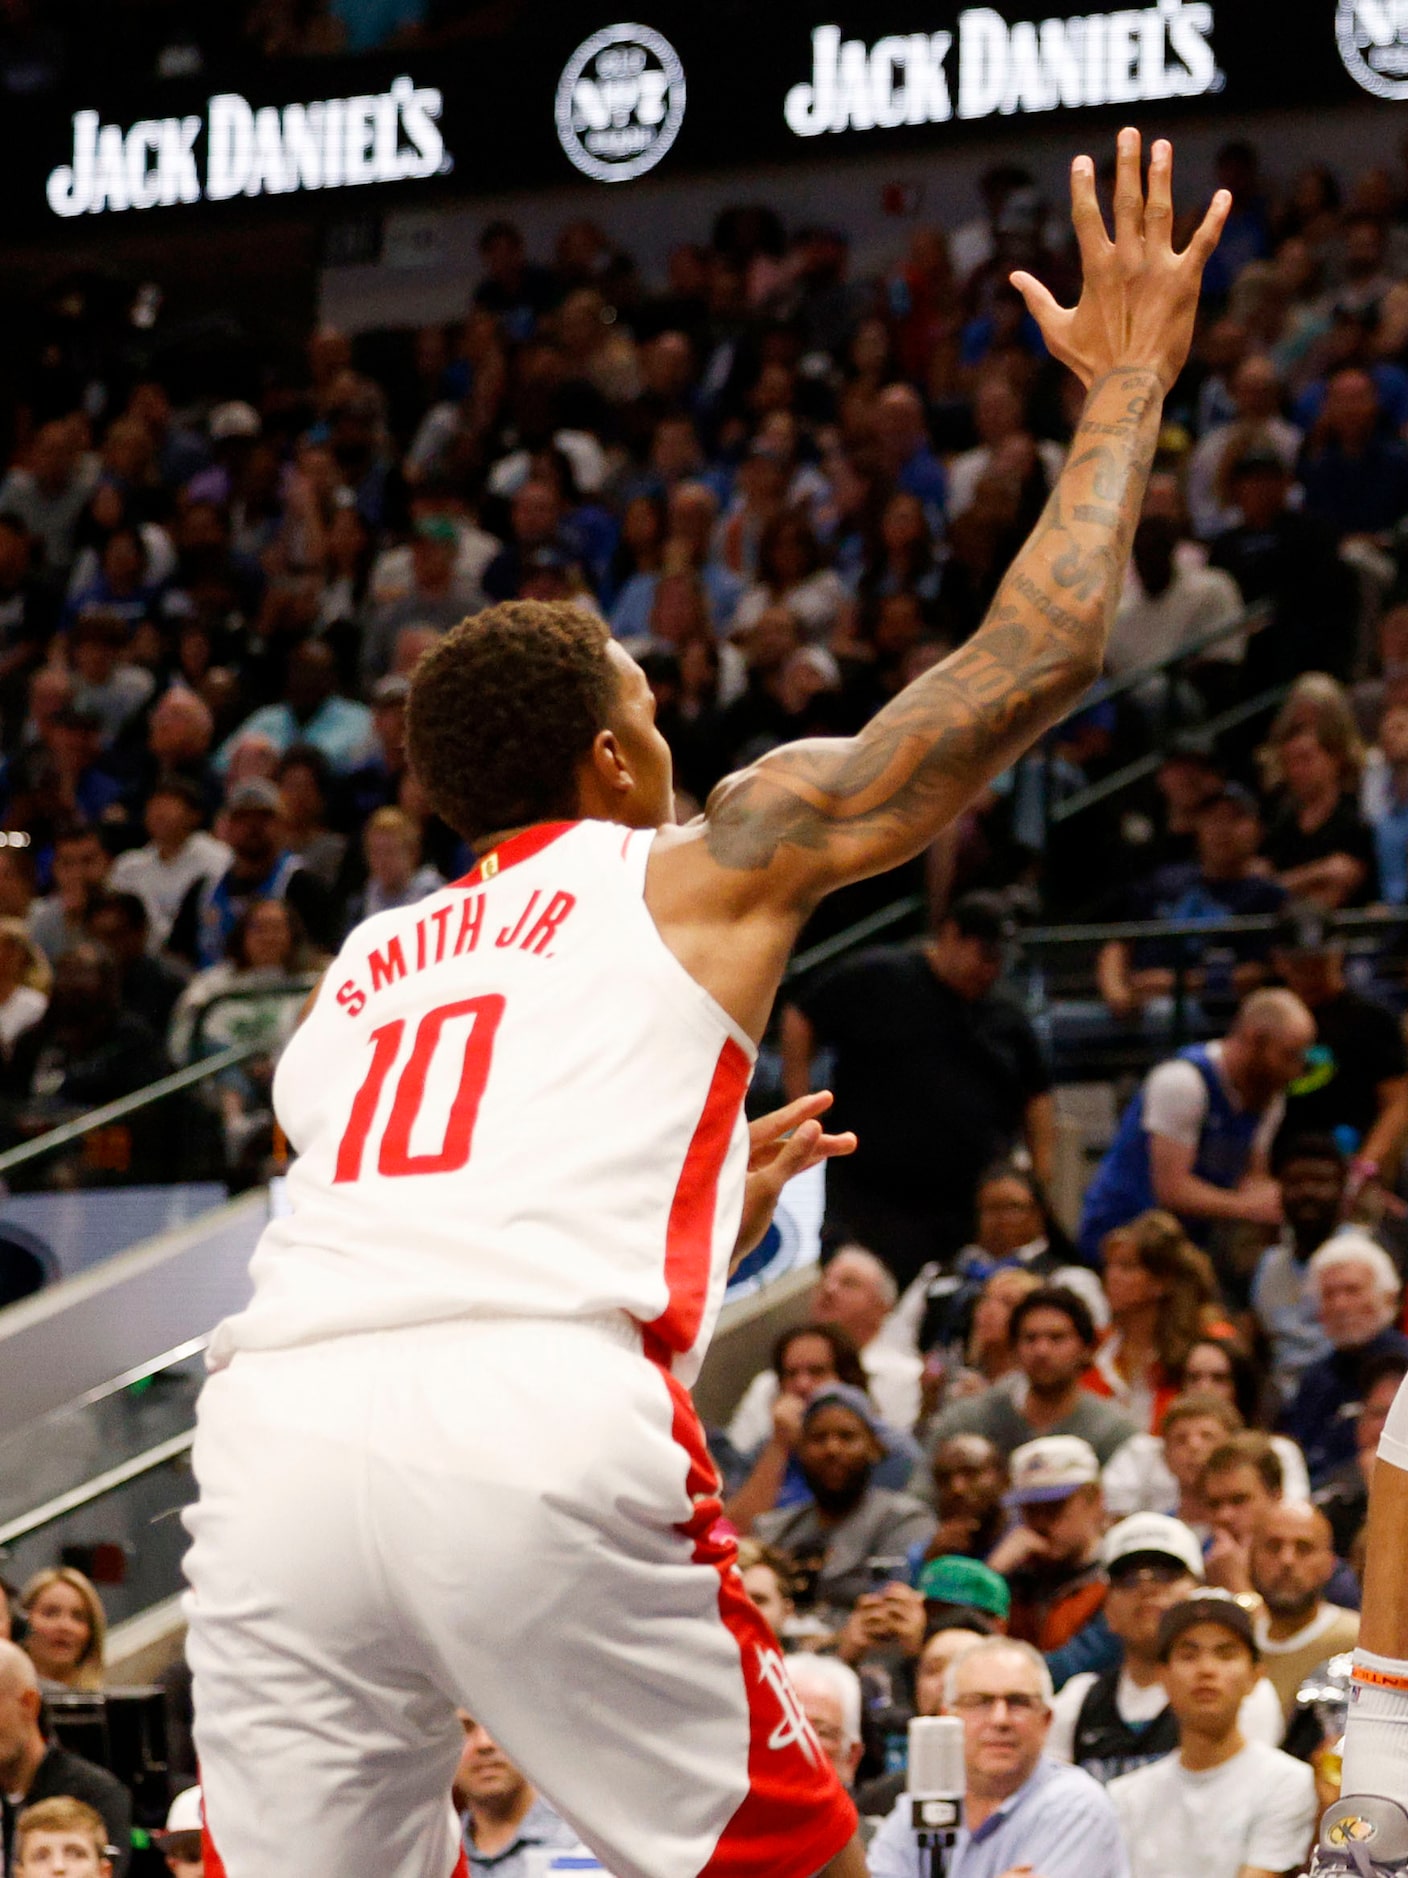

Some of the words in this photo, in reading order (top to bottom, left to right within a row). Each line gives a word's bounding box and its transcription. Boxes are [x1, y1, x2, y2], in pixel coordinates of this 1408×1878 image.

[784, 24, 952, 136] JACK
[958, 0, 1215, 119] DANIEL'S
[46, 110, 201, 217] JACK
[207, 75, 444, 200] DANIEL'S
[336, 892, 488, 1018] SMITH
[494, 889, 577, 959] JR.
[331, 992, 507, 1185] 10
